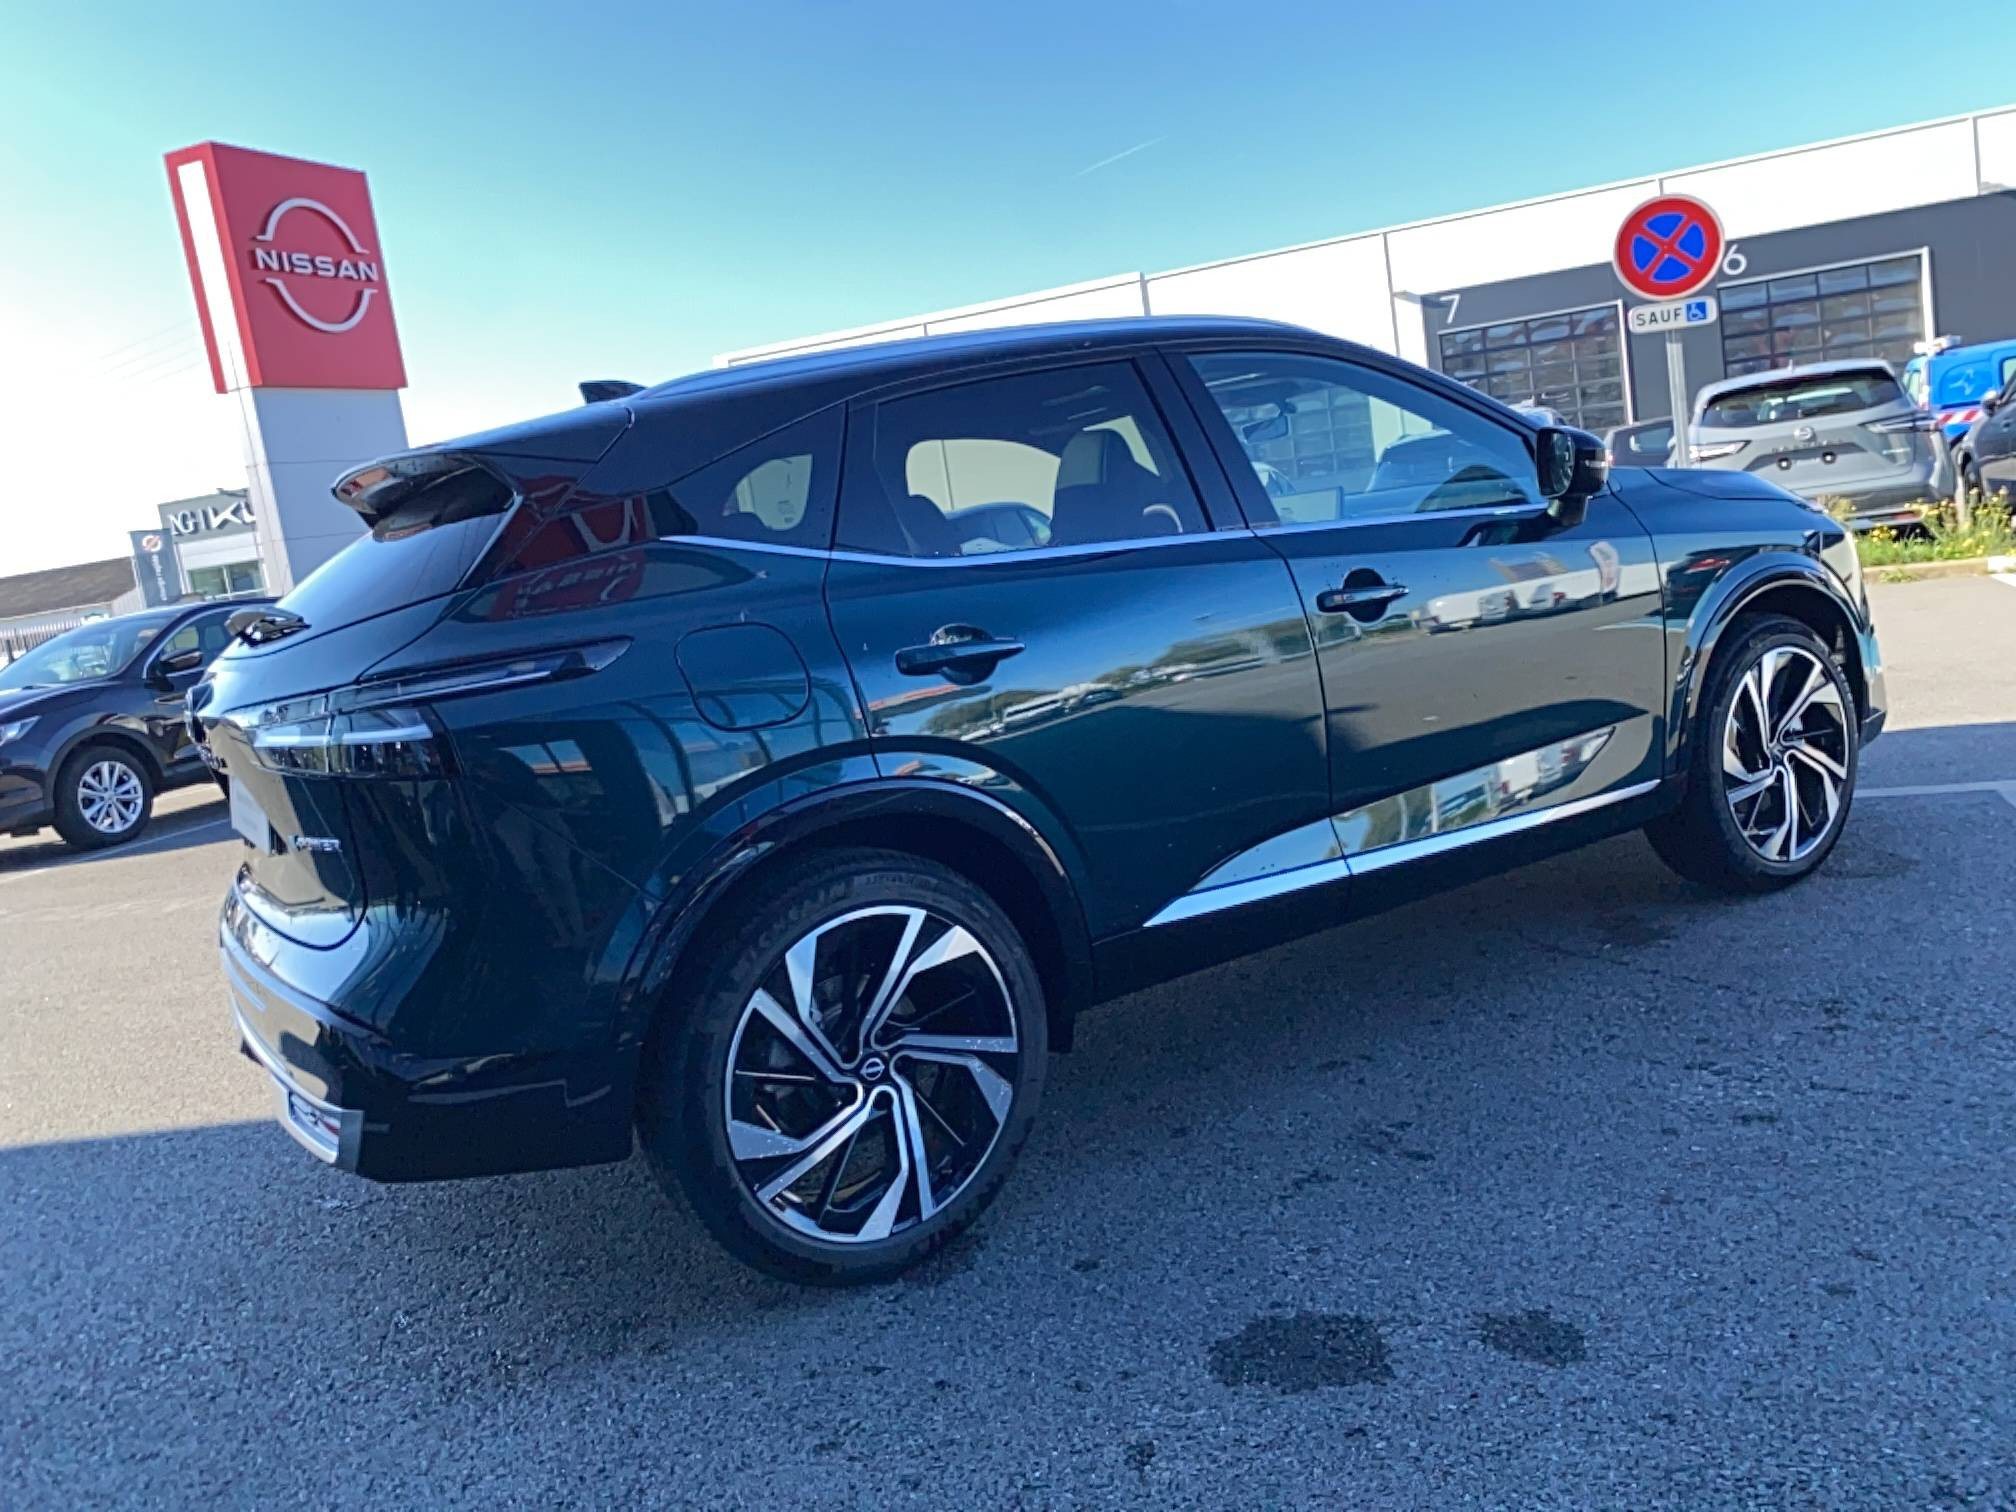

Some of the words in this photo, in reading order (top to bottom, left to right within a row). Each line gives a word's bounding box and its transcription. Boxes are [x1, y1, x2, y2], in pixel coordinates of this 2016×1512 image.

[255, 247, 380, 282] NISSAN
[1724, 244, 1748, 275] 6
[1440, 294, 1462, 324] 7
[1635, 307, 1683, 328] SAUF
